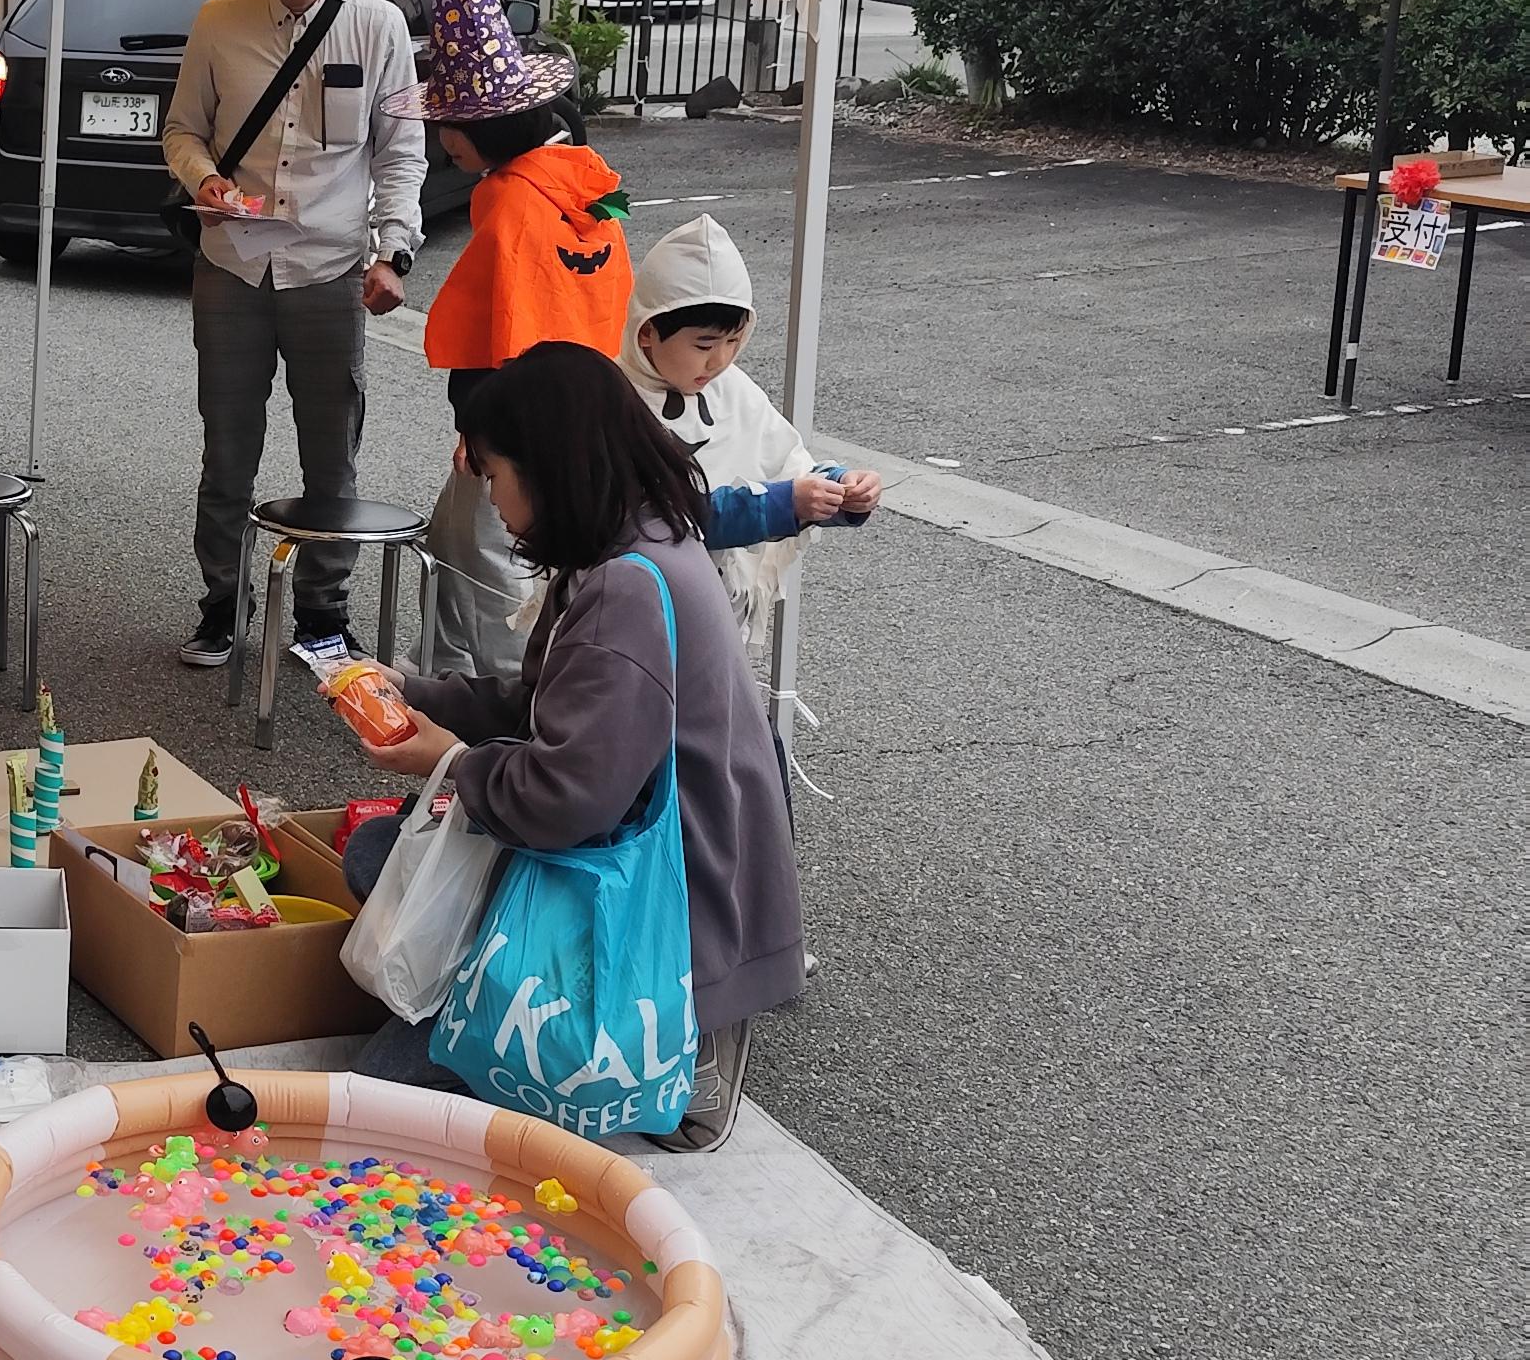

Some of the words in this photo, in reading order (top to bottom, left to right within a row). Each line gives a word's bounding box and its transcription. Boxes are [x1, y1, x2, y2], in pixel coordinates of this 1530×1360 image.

[123, 96, 141, 108] 338
[1384, 210, 1441, 250] 受付
[488, 1067, 643, 1134] COFFEE
